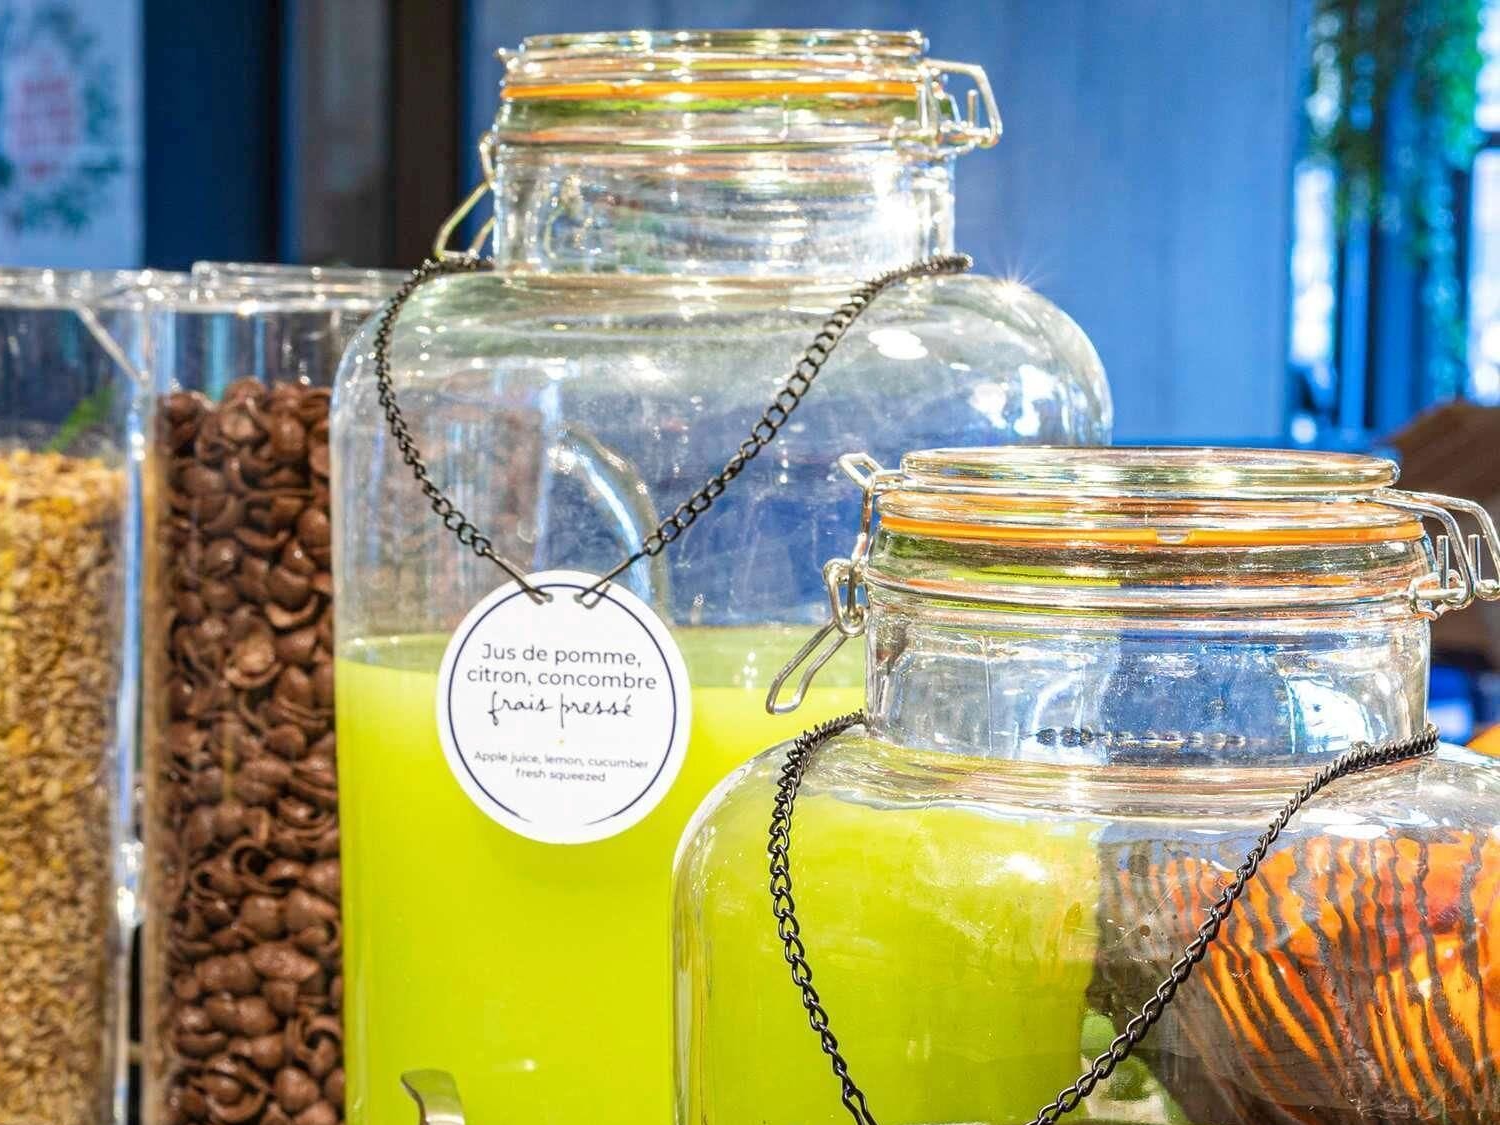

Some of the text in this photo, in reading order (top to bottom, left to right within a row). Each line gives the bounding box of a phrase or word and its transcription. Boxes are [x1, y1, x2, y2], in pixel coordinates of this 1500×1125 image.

[482, 643, 642, 668] Jus de pomme,
[467, 665, 657, 690] citron, concombre
[488, 690, 632, 728] frais pressé
[474, 750, 508, 764] Apple
[588, 756, 648, 768] cucumber
[516, 768, 606, 783] fresh squeezed
